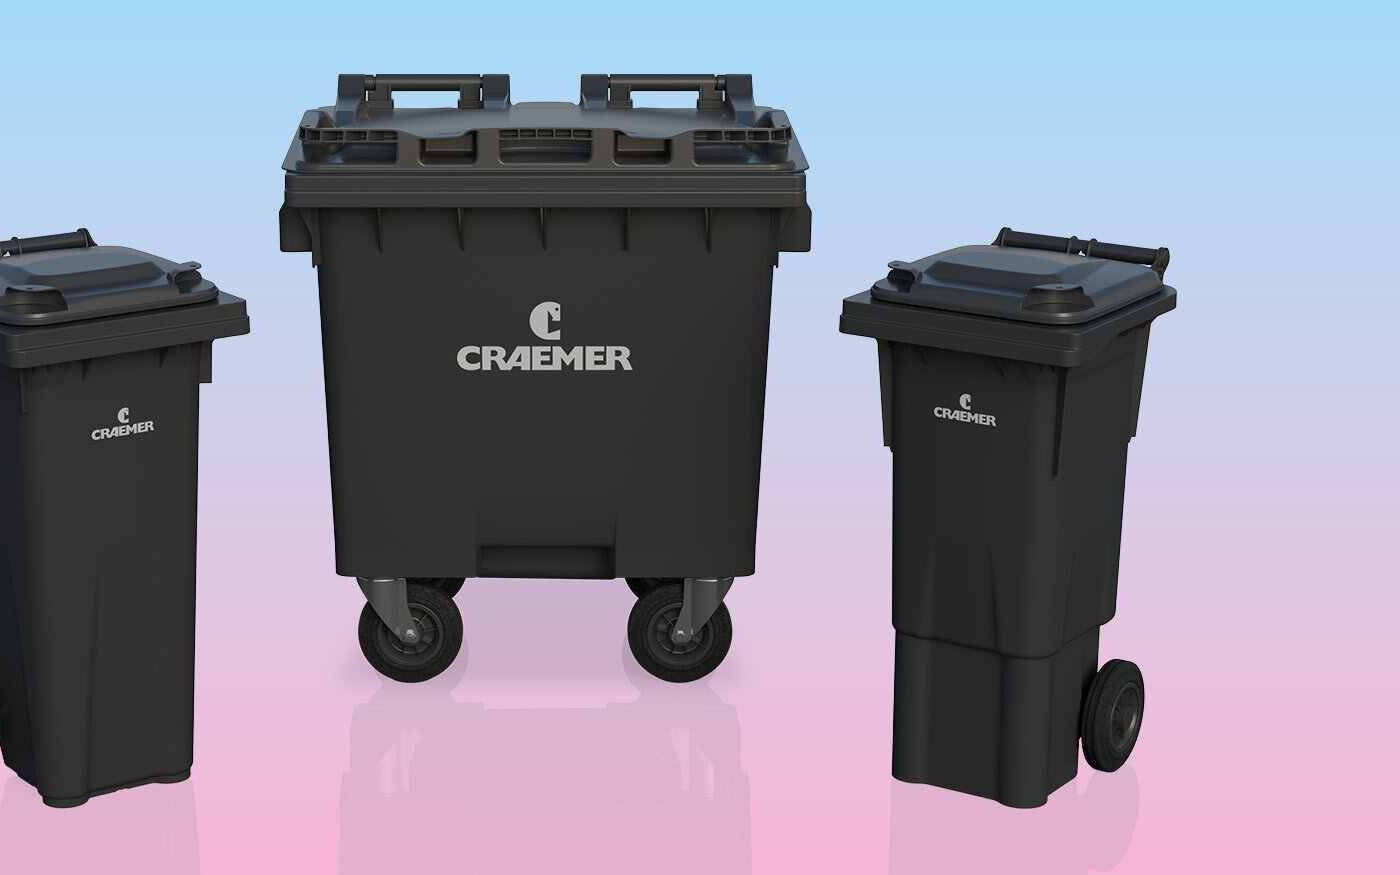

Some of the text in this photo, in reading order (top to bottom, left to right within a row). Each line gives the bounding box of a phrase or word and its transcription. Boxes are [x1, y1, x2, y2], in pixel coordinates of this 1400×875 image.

[456, 345, 634, 371] CRAEMER
[933, 406, 997, 427] CRAEMER
[91, 420, 155, 441] CRAEMER
